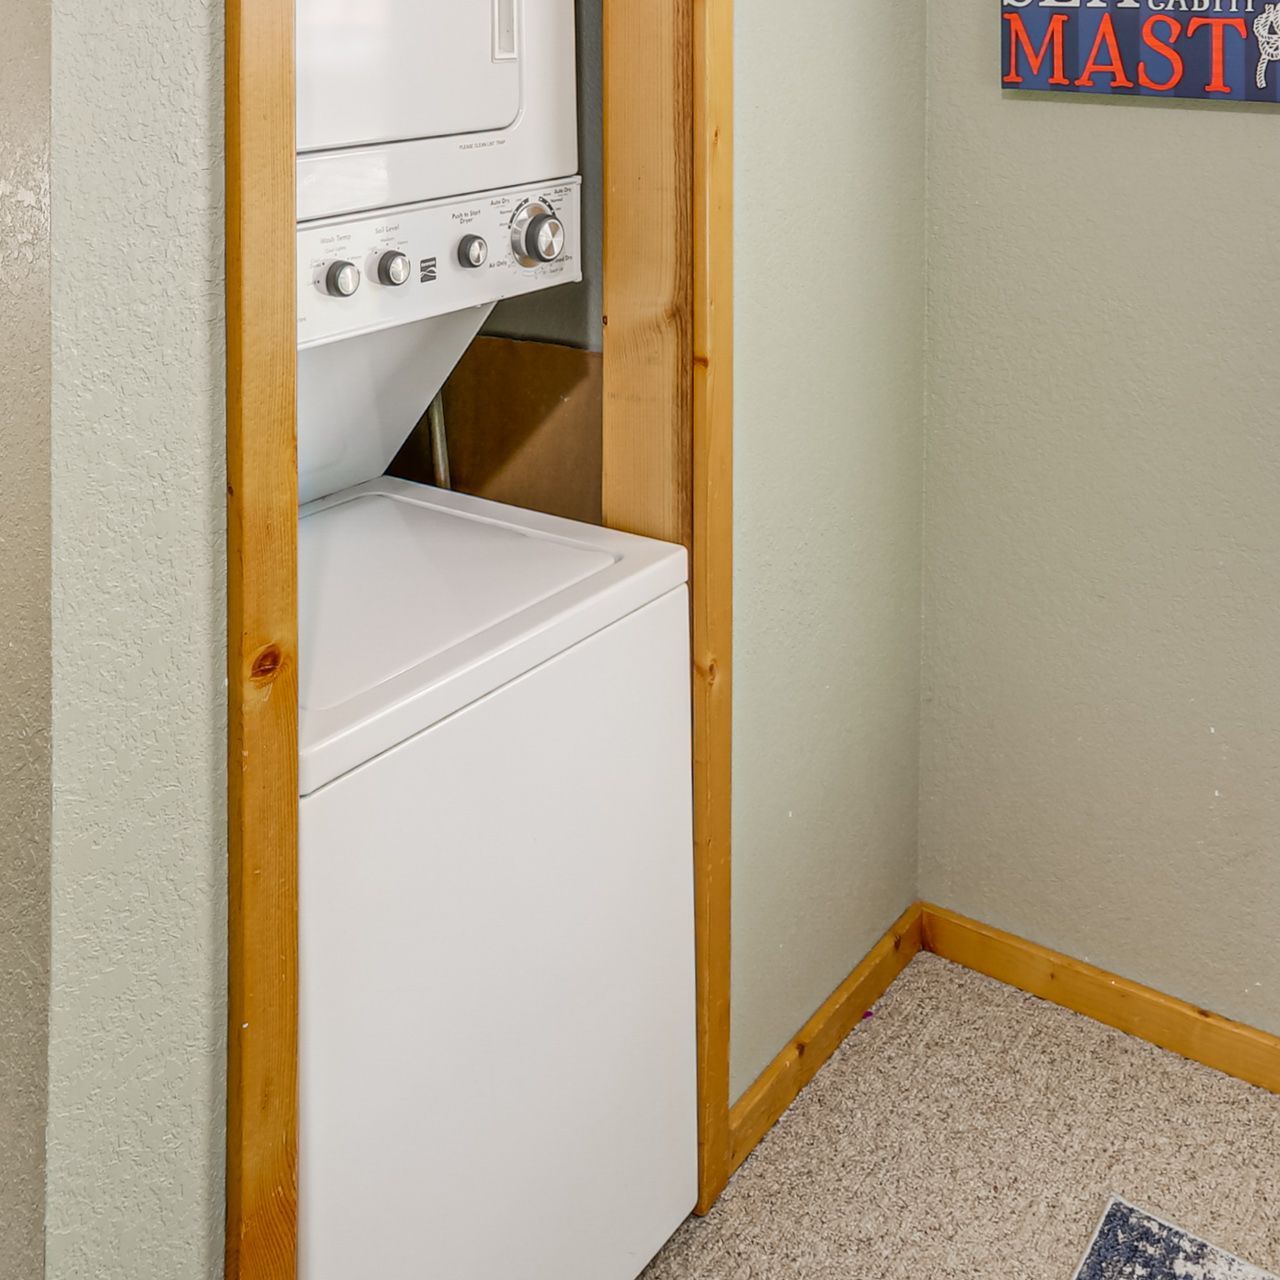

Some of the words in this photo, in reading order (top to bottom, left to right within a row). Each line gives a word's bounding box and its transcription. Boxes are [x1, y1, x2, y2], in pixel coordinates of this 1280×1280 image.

[1003, 12, 1248, 93] MAST
[470, 209, 481, 217] Start
[460, 217, 473, 225] Dryer
[375, 226, 384, 234] Soil
[385, 224, 400, 233] Level
